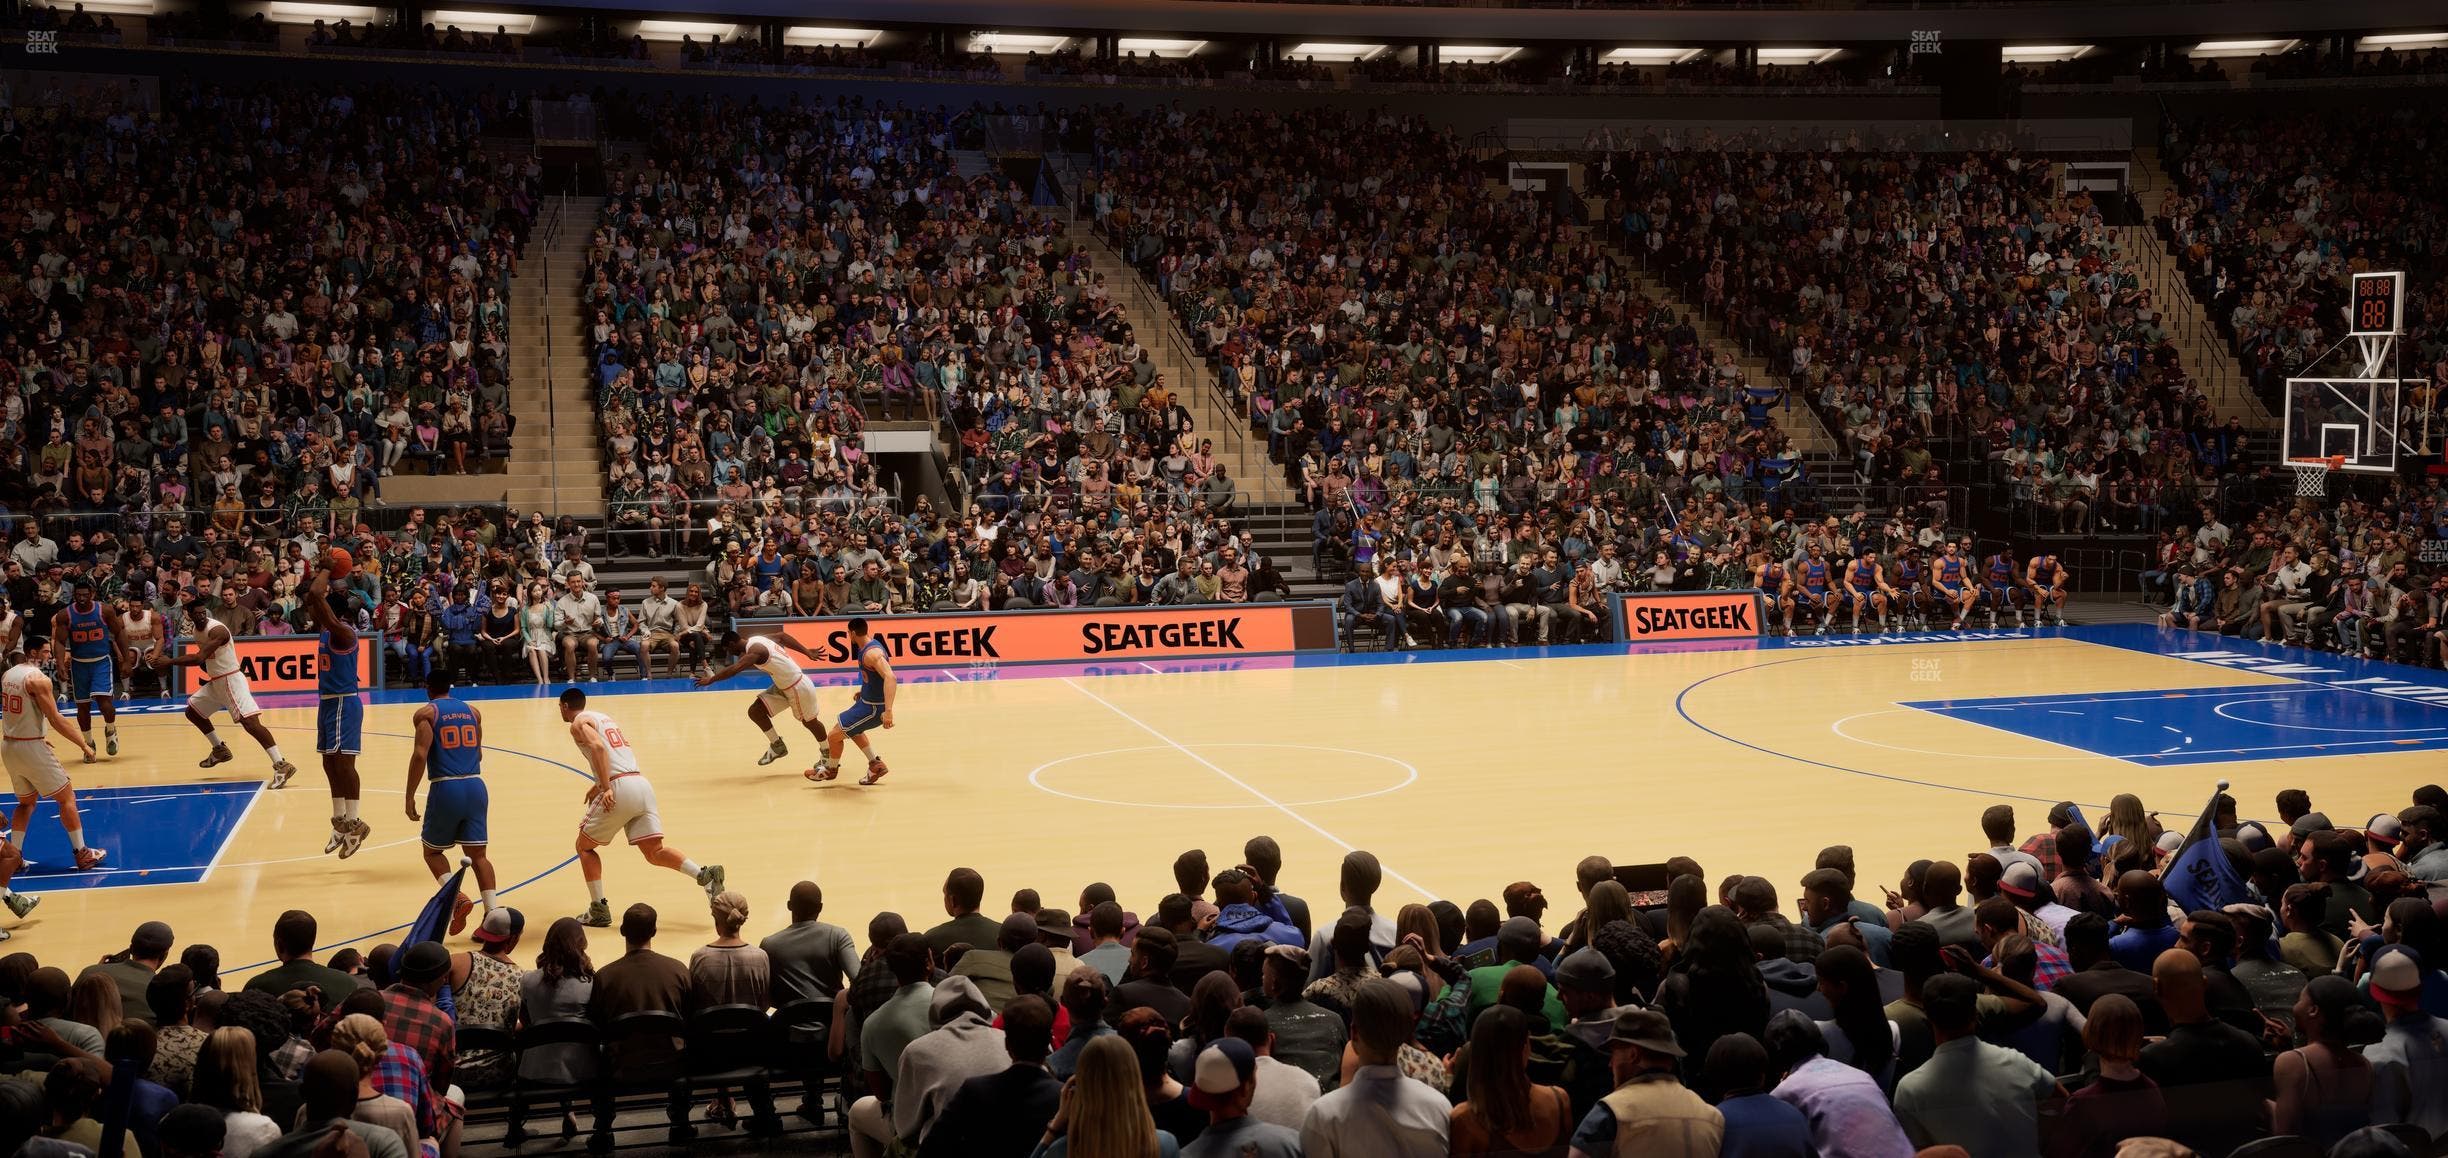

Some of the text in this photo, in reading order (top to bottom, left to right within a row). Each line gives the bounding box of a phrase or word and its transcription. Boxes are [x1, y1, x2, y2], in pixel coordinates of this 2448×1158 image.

[2362, 300, 2386, 328] 88
[1635, 602, 1752, 635] SEATGEEK
[1082, 617, 1245, 654] SEATGEEK
[2164, 650, 2346, 674] NEW
[441, 712, 473, 721] PLAYER
[440, 724, 477, 750] 00
